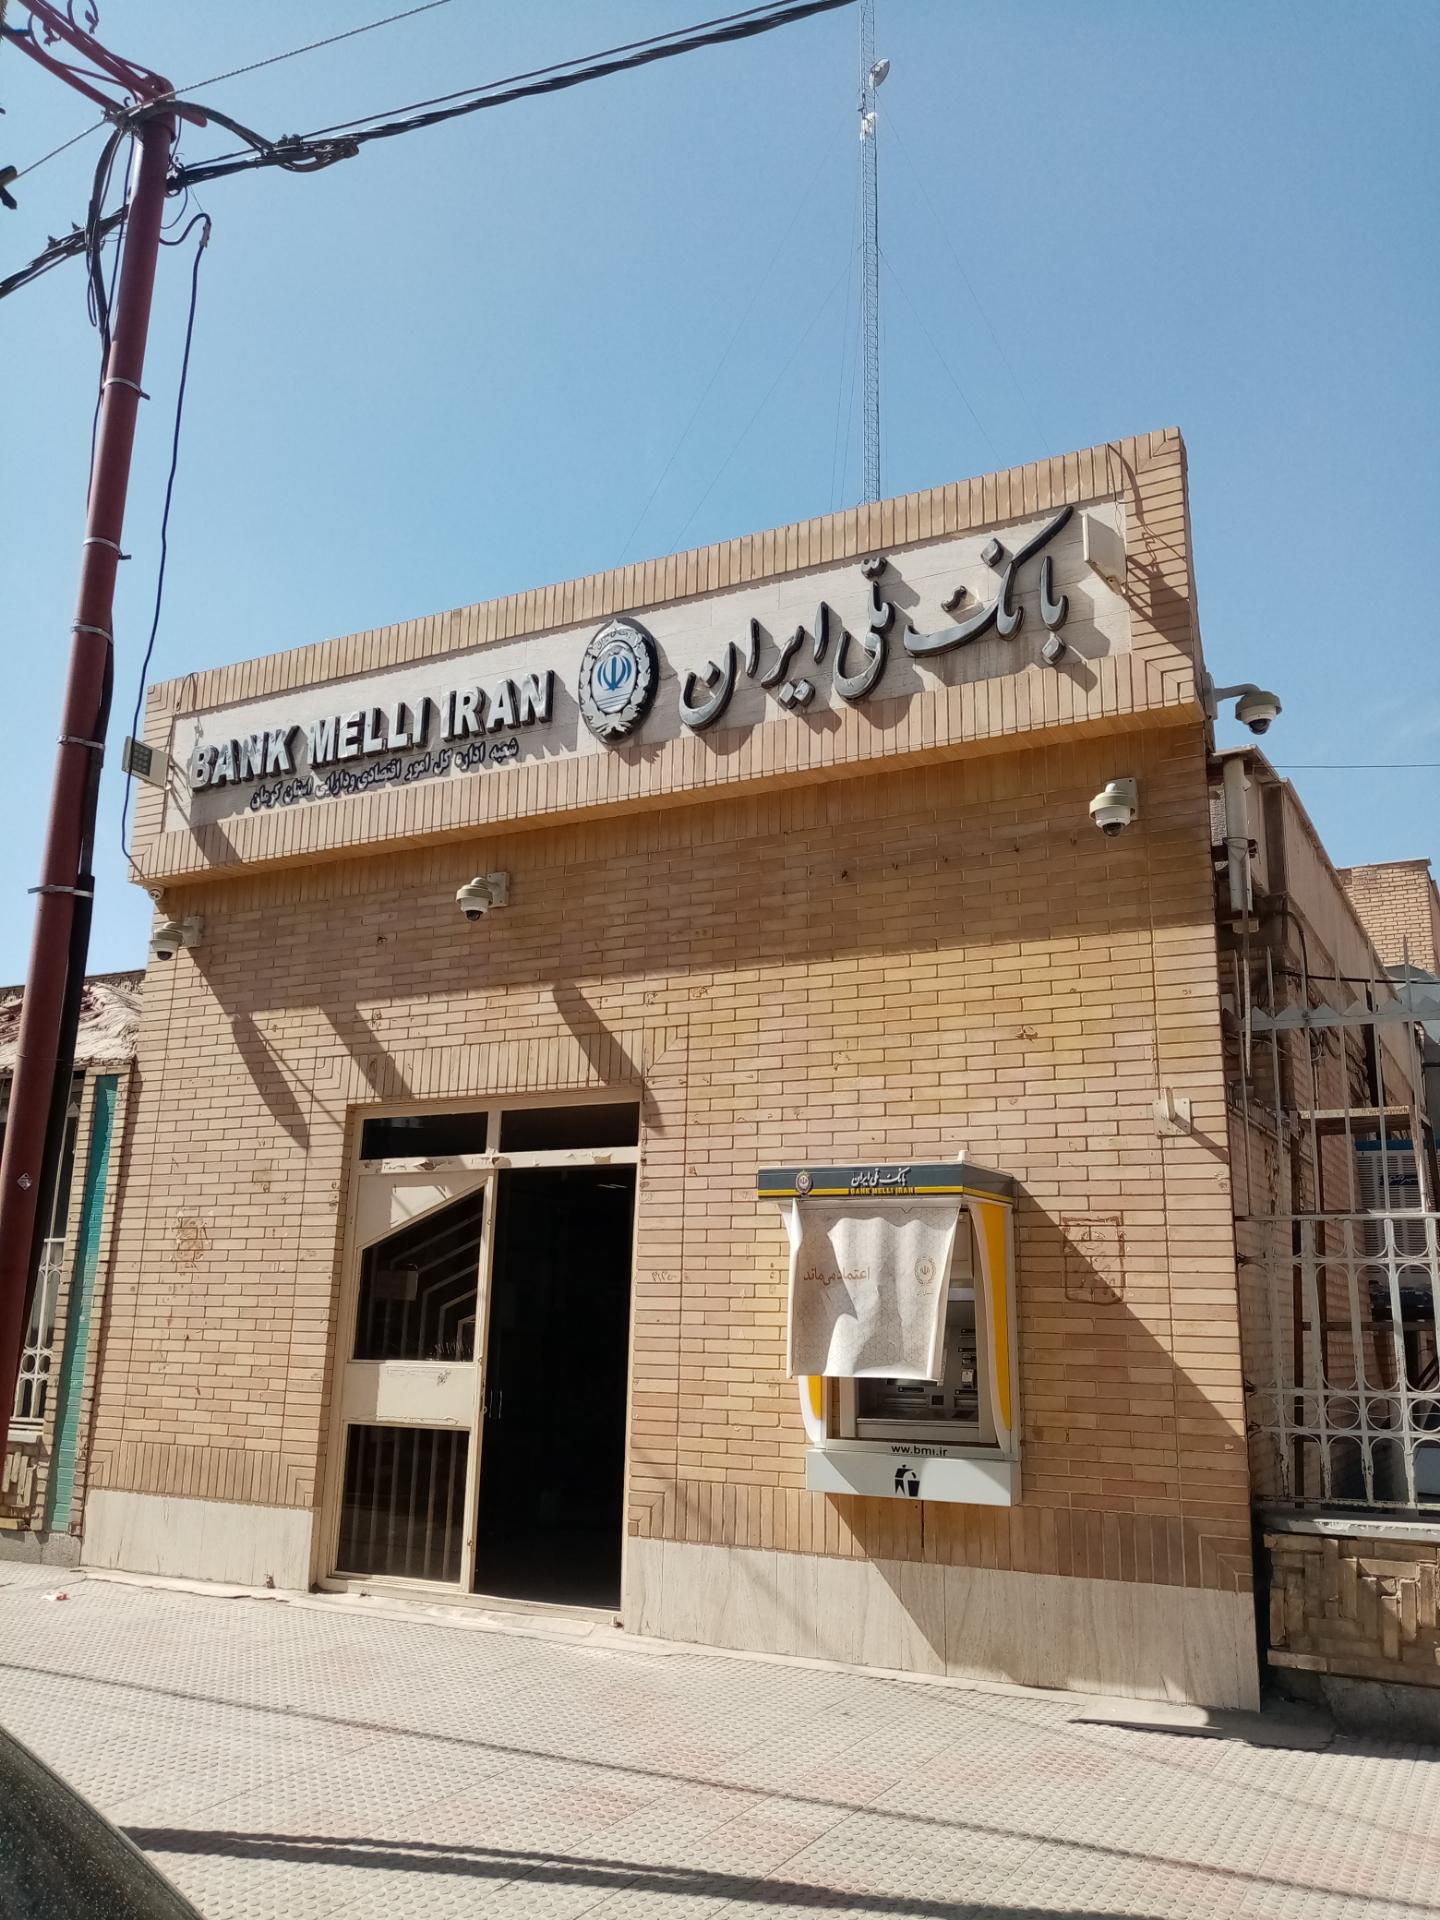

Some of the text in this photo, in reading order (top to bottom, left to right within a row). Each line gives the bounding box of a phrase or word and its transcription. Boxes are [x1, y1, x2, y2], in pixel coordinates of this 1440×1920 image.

[903, 505, 1071, 666] بانک
[678, 601, 830, 731] ایران
[191, 670, 555, 791] BANK MELLI IRAN
[432, 748, 454, 775] کل
[454, 742, 486, 770] اداره
[489, 737, 519, 764] شعبه
[357, 757, 402, 789] اقتصادی
[404, 752, 431, 780] امور
[250, 781, 283, 811] کرمان
[283, 777, 314, 804] استان
[851, 1171, 870, 1187] ایران
[879, 1167, 911, 1186] بانک
[836, 1266, 870, 1281] اعتماد
